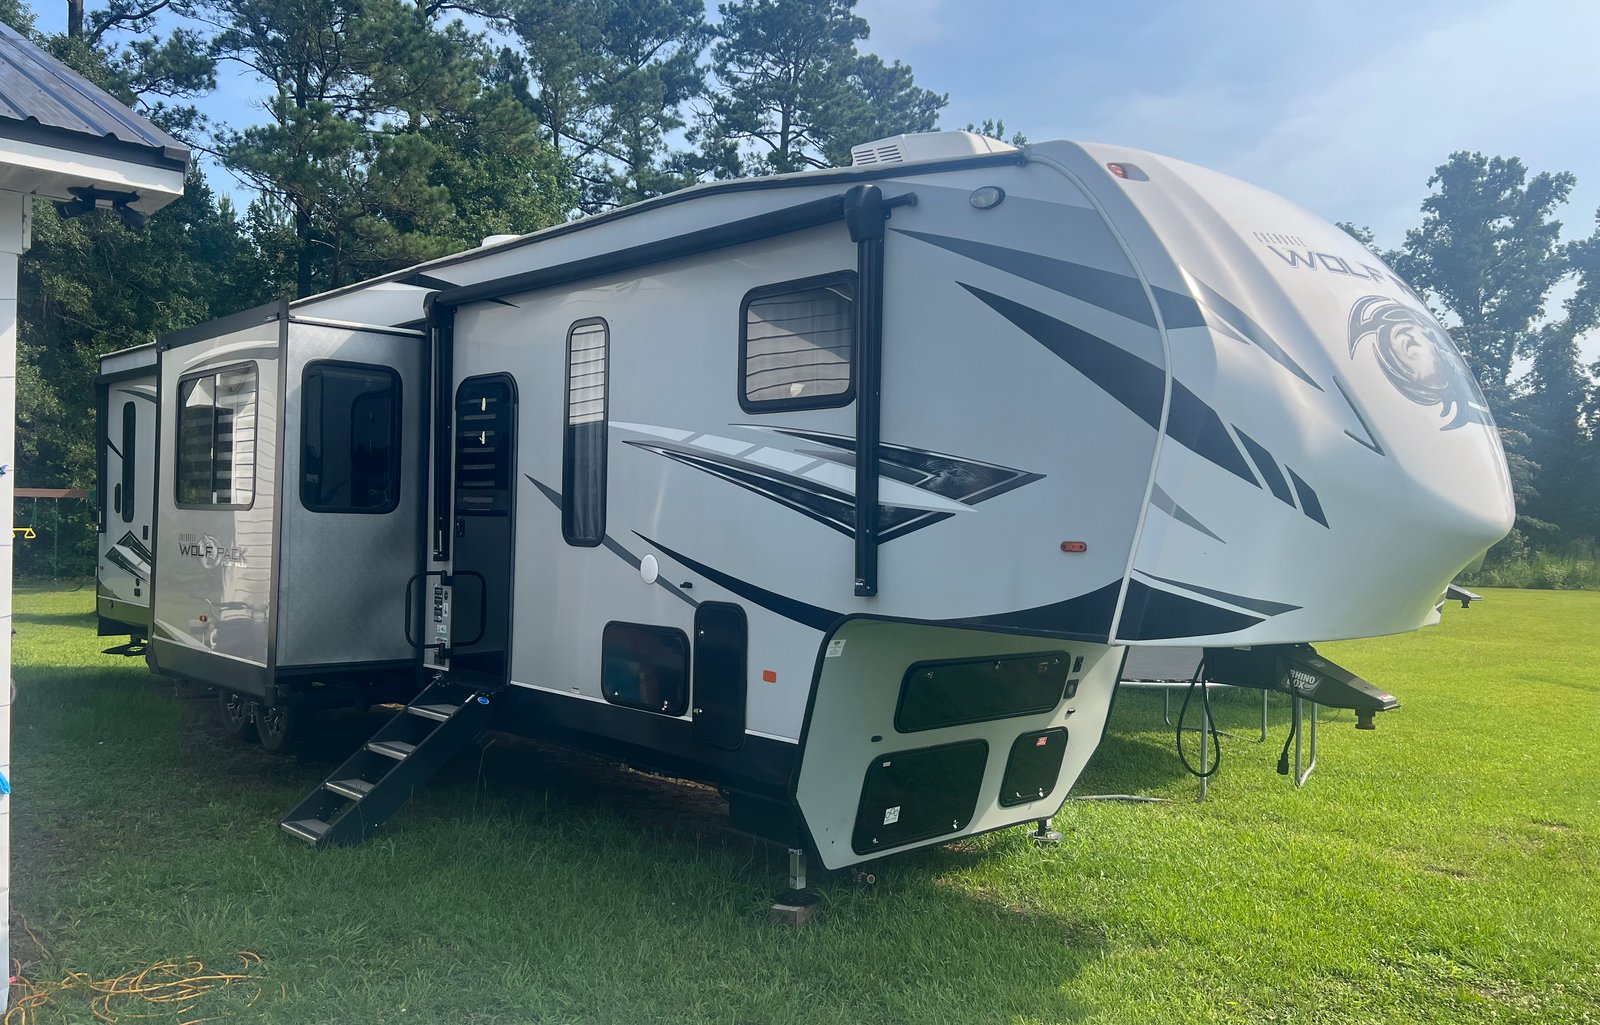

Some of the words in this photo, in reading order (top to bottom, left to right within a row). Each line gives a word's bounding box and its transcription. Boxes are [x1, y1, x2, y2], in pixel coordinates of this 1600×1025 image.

[1266, 245, 1385, 285] WOLF
[179, 543, 214, 558] WOLF
[216, 546, 248, 563] PACK
[1290, 669, 1316, 684] RHINO
